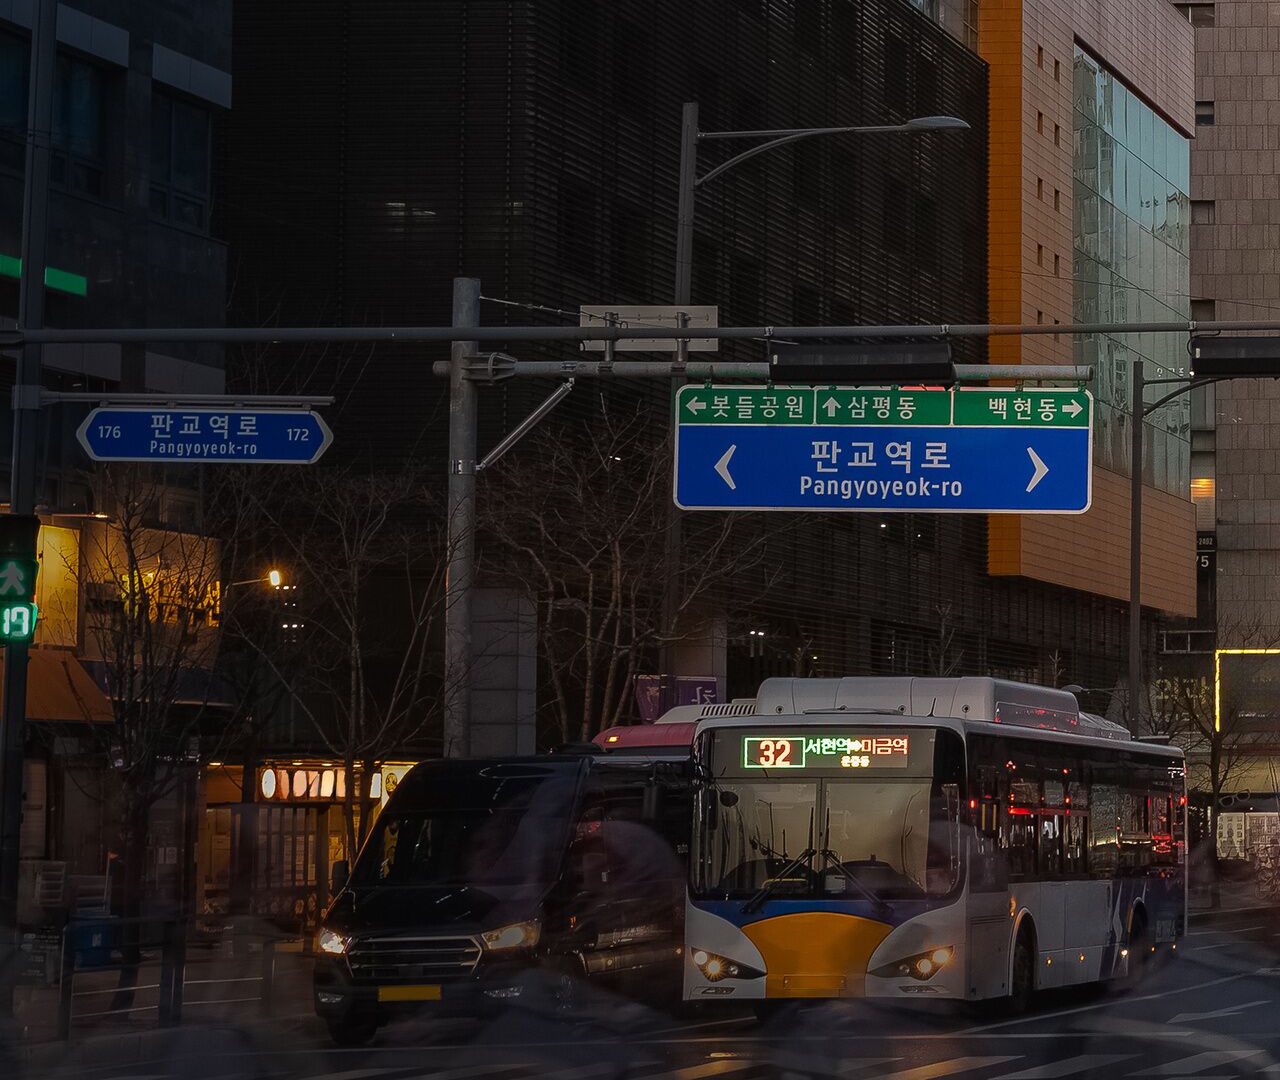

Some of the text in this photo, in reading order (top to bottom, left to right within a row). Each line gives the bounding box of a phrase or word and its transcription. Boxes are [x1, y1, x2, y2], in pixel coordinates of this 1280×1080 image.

[711, 396, 804, 419] 봇들공원
[847, 396, 918, 420] 삼평동
[987, 398, 1058, 422] 백현동
[98, 425, 121, 439] 176
[151, 414, 259, 439] 판교역로
[287, 428, 309, 441] 172
[150, 440, 257, 457] Pangyoyeok-ro
[811, 440, 951, 474] 판교역로
[800, 475, 963, 500] Pangyoyeok-ro
[759, 739, 792, 767] 32
[805, 738, 908, 755] 서현역 미금역
